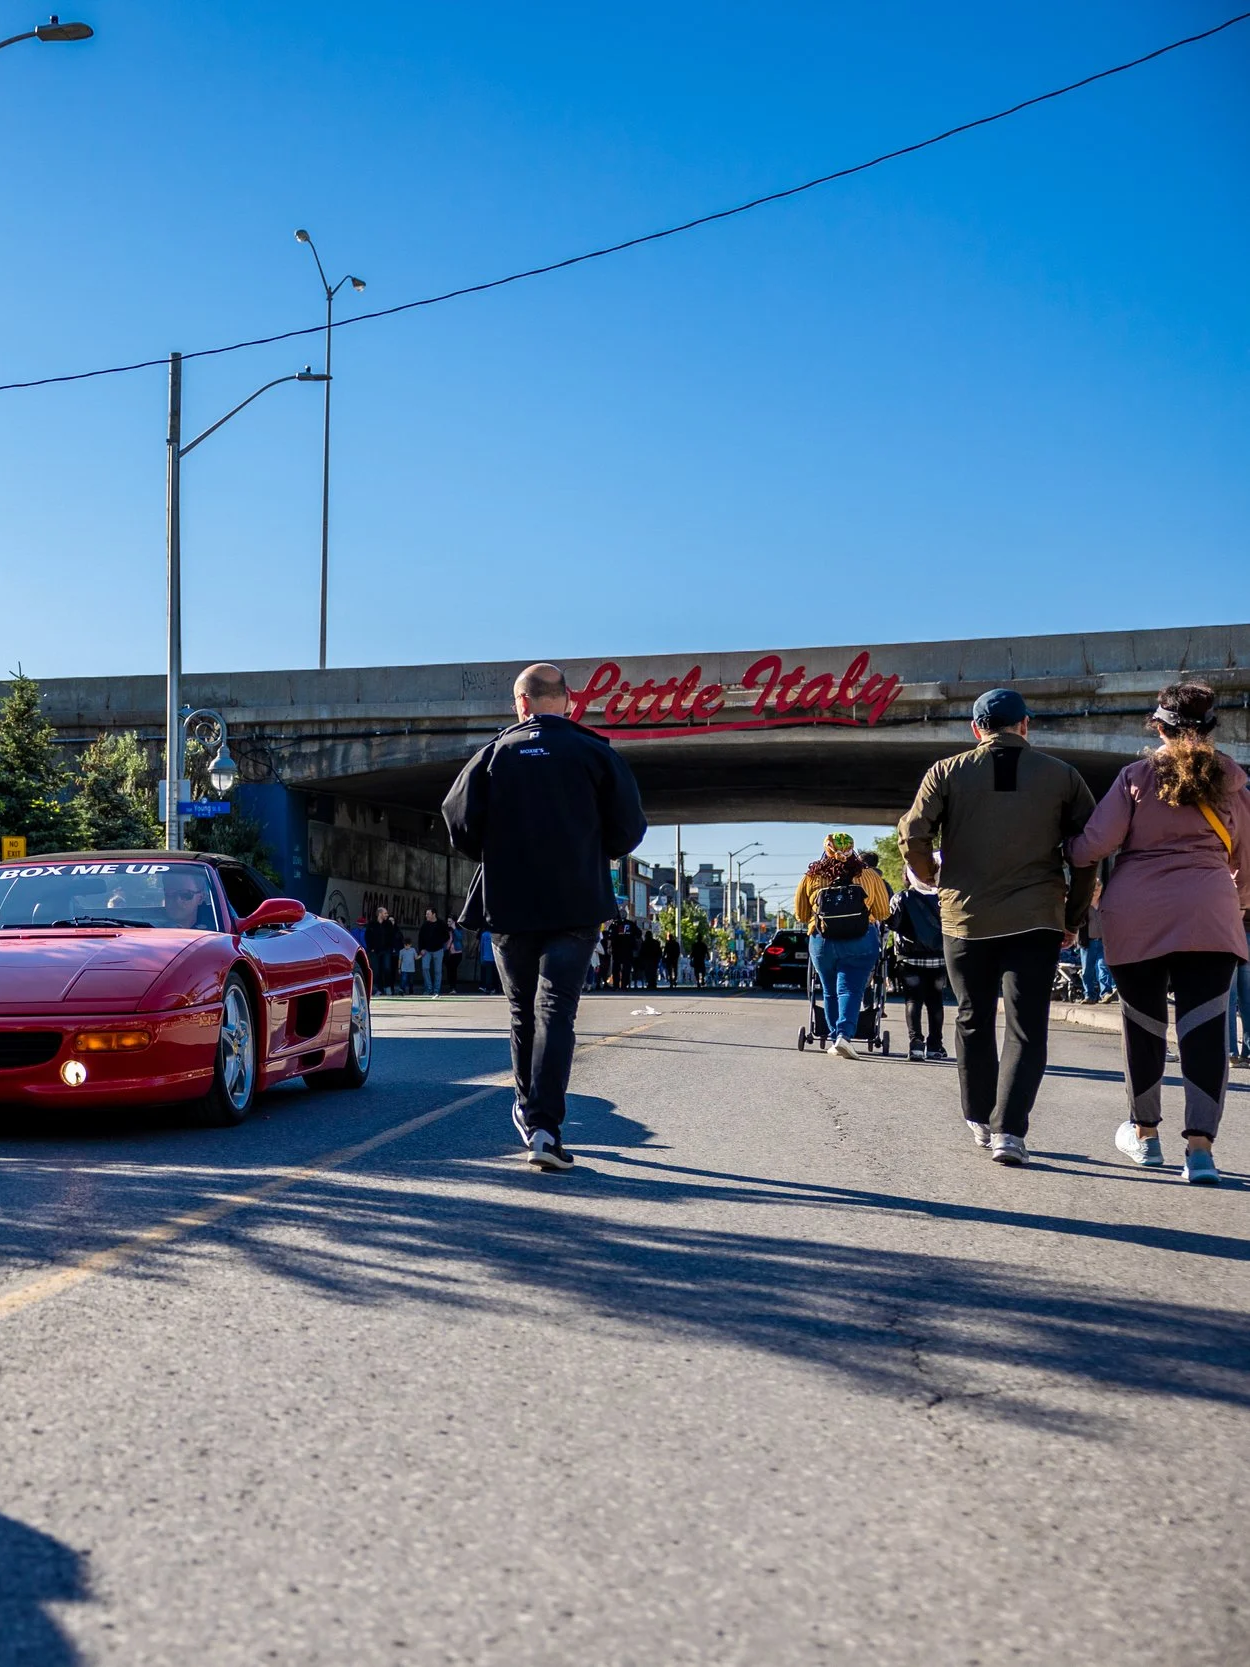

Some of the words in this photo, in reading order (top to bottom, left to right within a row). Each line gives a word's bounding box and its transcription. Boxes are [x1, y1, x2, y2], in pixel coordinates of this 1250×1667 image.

[567, 662, 724, 724] Little
[742, 650, 903, 726] Italy
[8, 840, 19, 848] NO
[7, 850, 21, 859] EXIT
[70, 864, 119, 875] ME
[125, 864, 170, 875] UP
